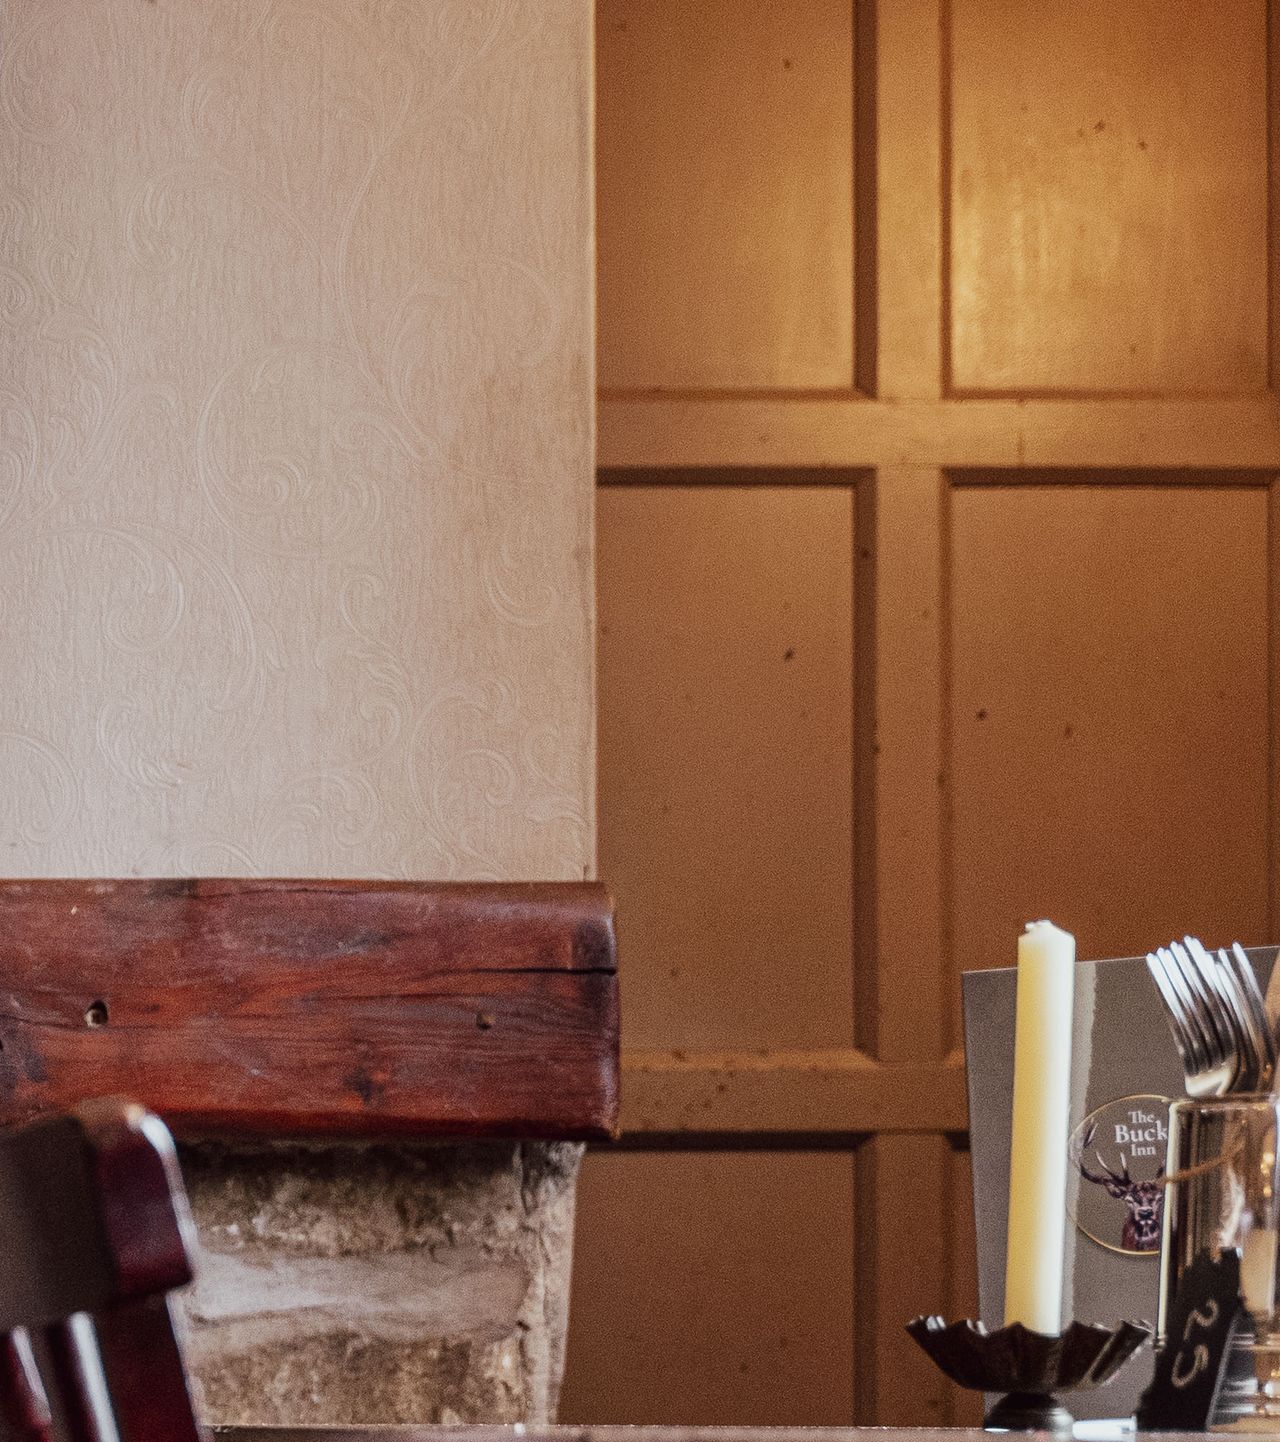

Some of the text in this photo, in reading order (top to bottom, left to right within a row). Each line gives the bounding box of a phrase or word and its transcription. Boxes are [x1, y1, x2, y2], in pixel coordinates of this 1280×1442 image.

[1127, 1110, 1155, 1124] The
[1114, 1120, 1168, 1143] Buck
[1130, 1144, 1156, 1156] Inn
